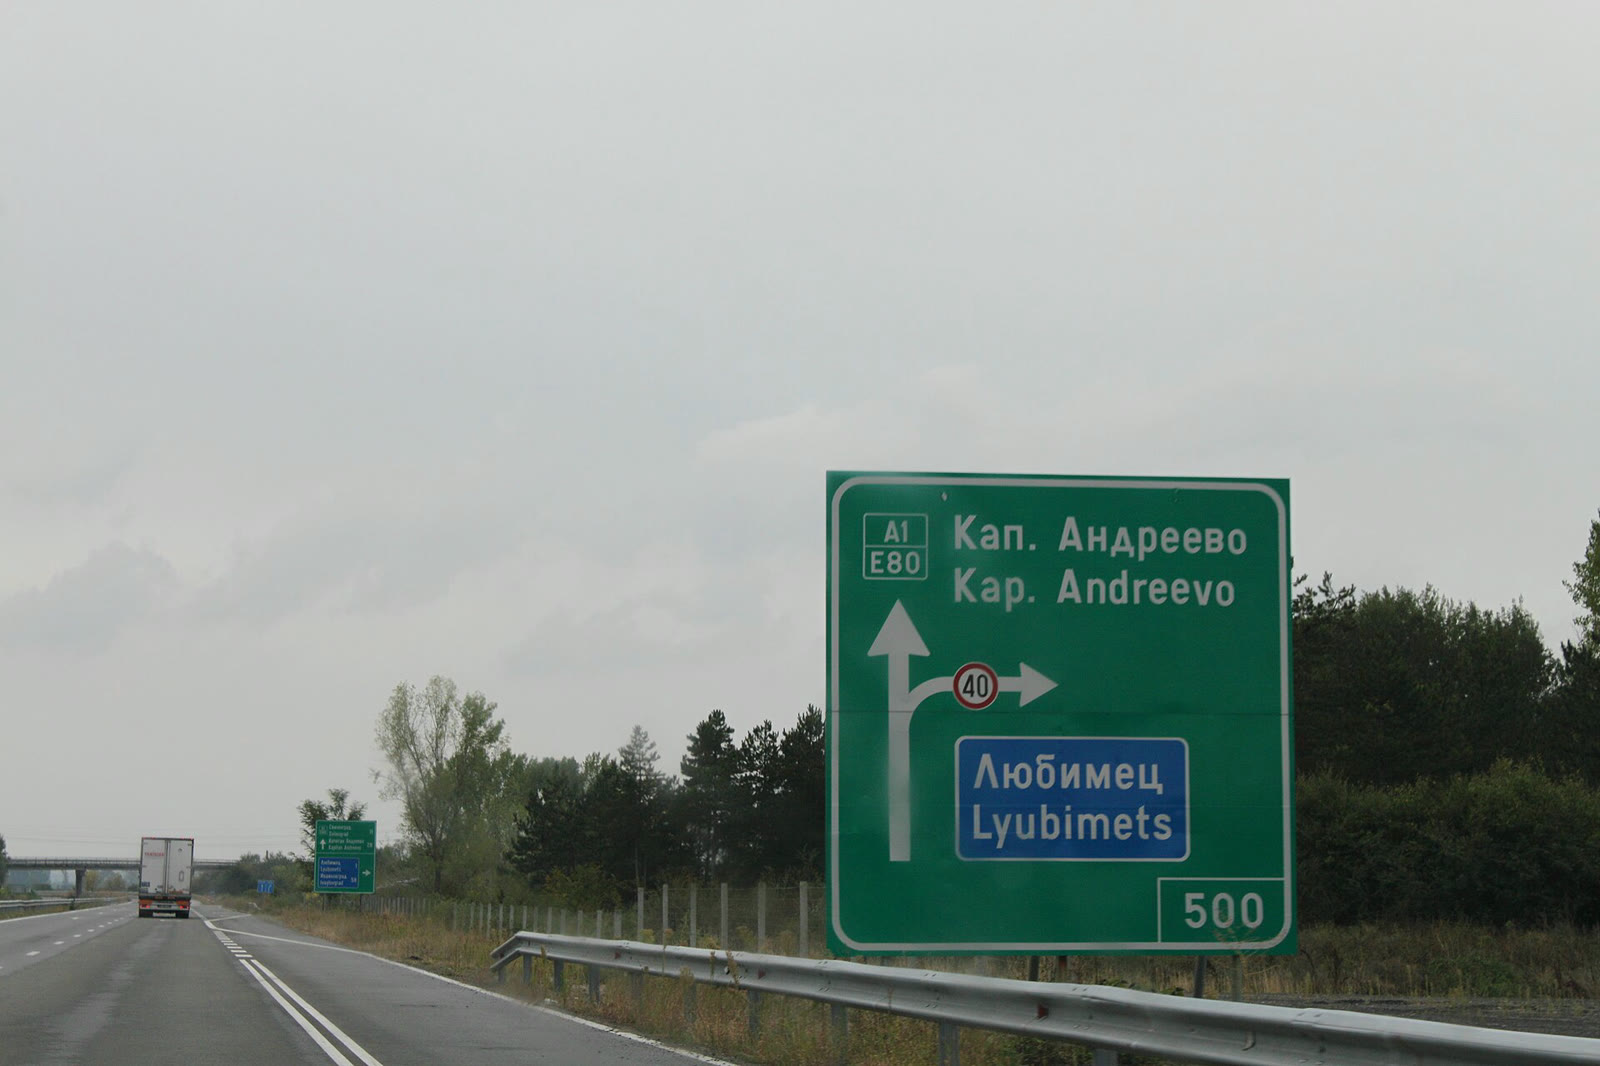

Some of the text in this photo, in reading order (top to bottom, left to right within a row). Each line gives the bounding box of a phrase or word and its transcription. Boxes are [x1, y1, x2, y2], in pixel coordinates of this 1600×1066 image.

[883, 520, 909, 544] A1
[953, 514, 1248, 561] Кап. Андреево
[870, 551, 921, 575] E80
[953, 567, 1236, 612] Kap. Andreevo
[962, 674, 989, 698] 40
[973, 752, 1164, 795] Любимец
[973, 804, 1173, 849] Lyubimets
[1184, 892, 1264, 928] 500
